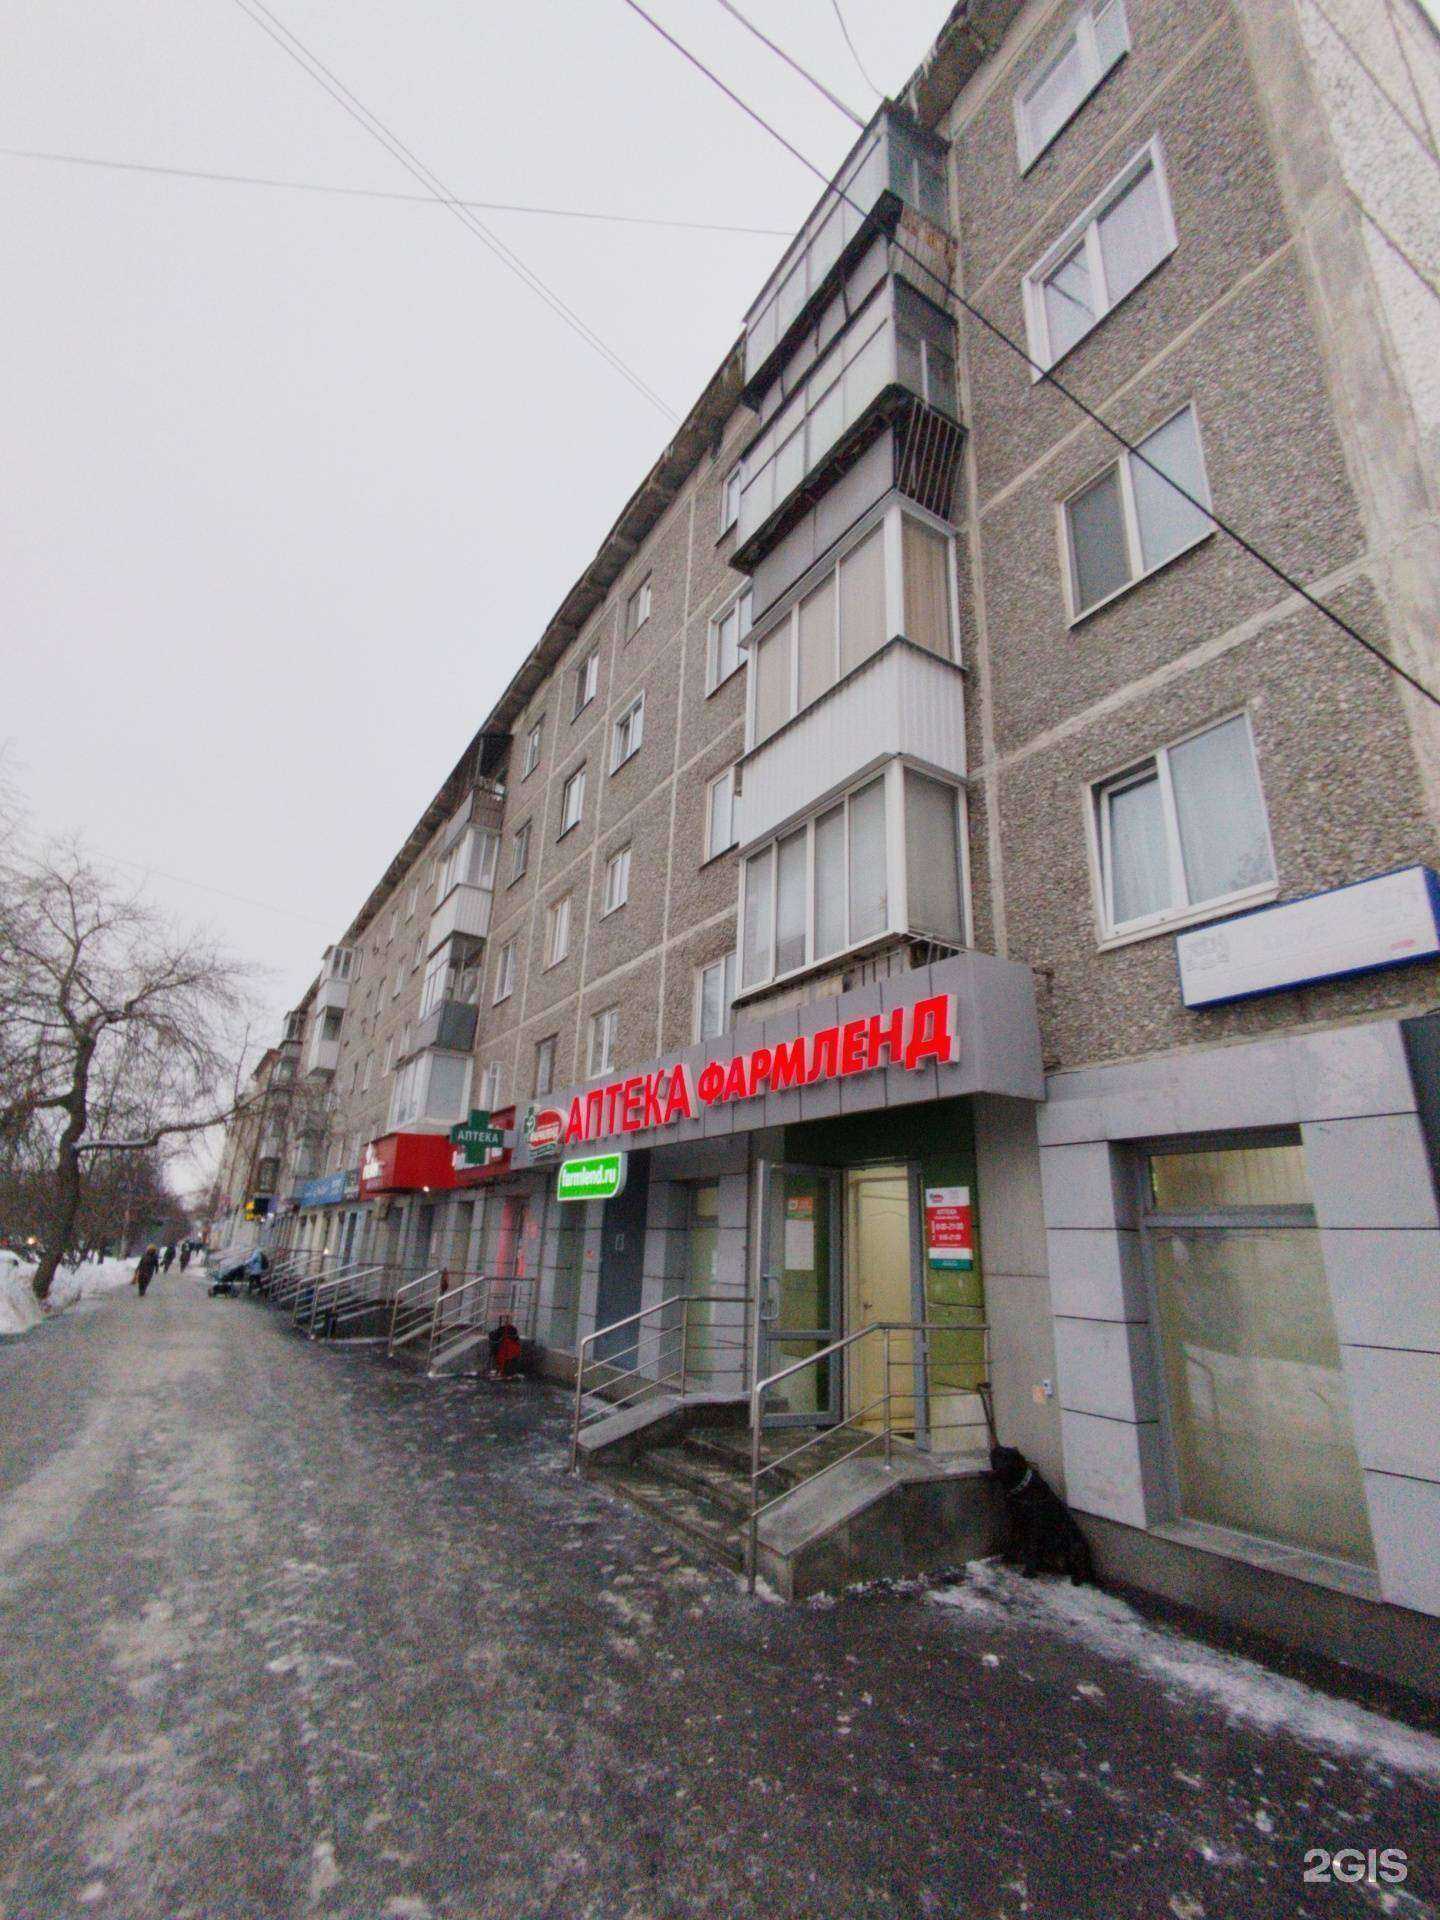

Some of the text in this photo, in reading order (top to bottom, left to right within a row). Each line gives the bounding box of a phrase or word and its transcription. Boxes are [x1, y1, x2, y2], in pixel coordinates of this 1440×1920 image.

[565, 994, 953, 1145] АПТЕКА ФАРМЛЕНД
[458, 1130, 499, 1143] АПТЕКА
[562, 1165, 617, 1187] farmlend.ru
